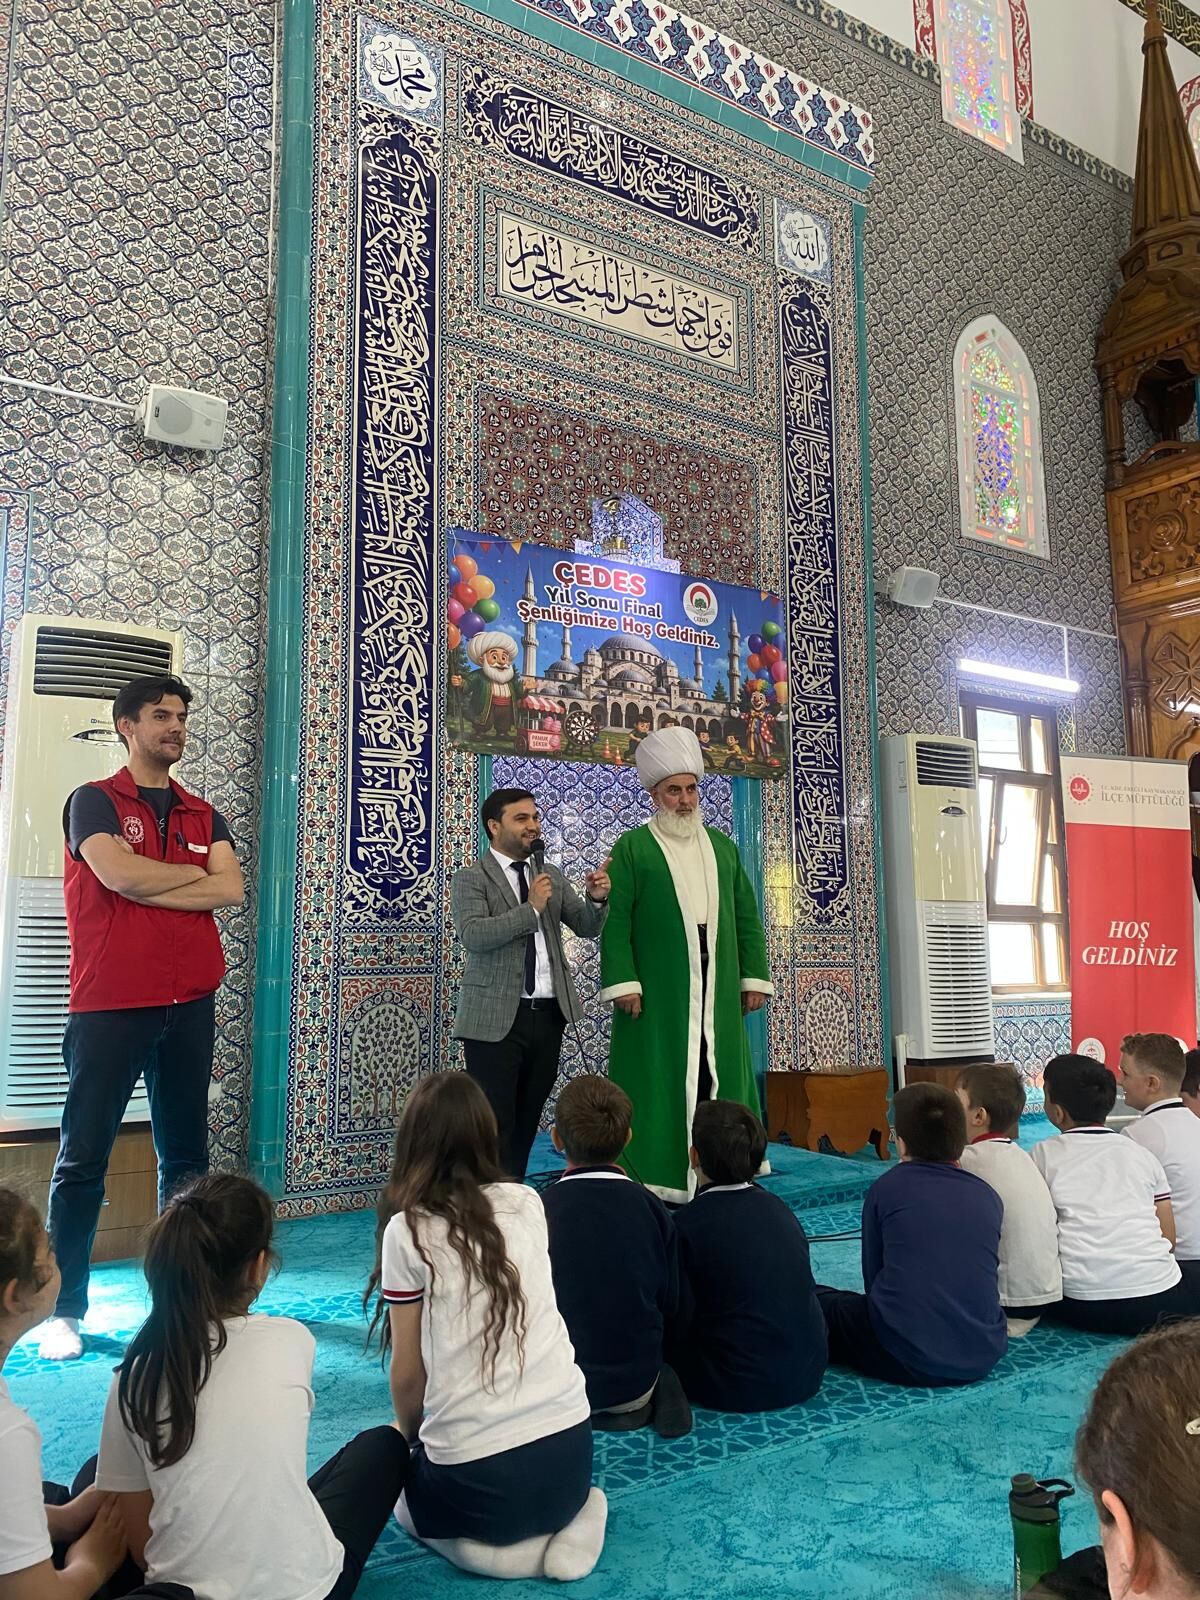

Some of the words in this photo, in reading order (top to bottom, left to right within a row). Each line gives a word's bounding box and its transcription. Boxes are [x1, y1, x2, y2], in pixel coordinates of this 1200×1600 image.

[553, 561, 646, 596] ÇEDES
[546, 586, 571, 604] Yıl
[576, 591, 618, 611] Sonu
[623, 598, 662, 618] Final
[518, 601, 618, 627] Şenliğimize
[622, 617, 652, 638] Hoş
[656, 623, 720, 648] Geldiniz.
[1101, 790, 1124, 804] İLÇE
[1126, 792, 1185, 807] MÜFTÜLÜĞÜ
[1108, 920, 1150, 943] HOŞ
[1082, 943, 1179, 967] GELDİNİZ
